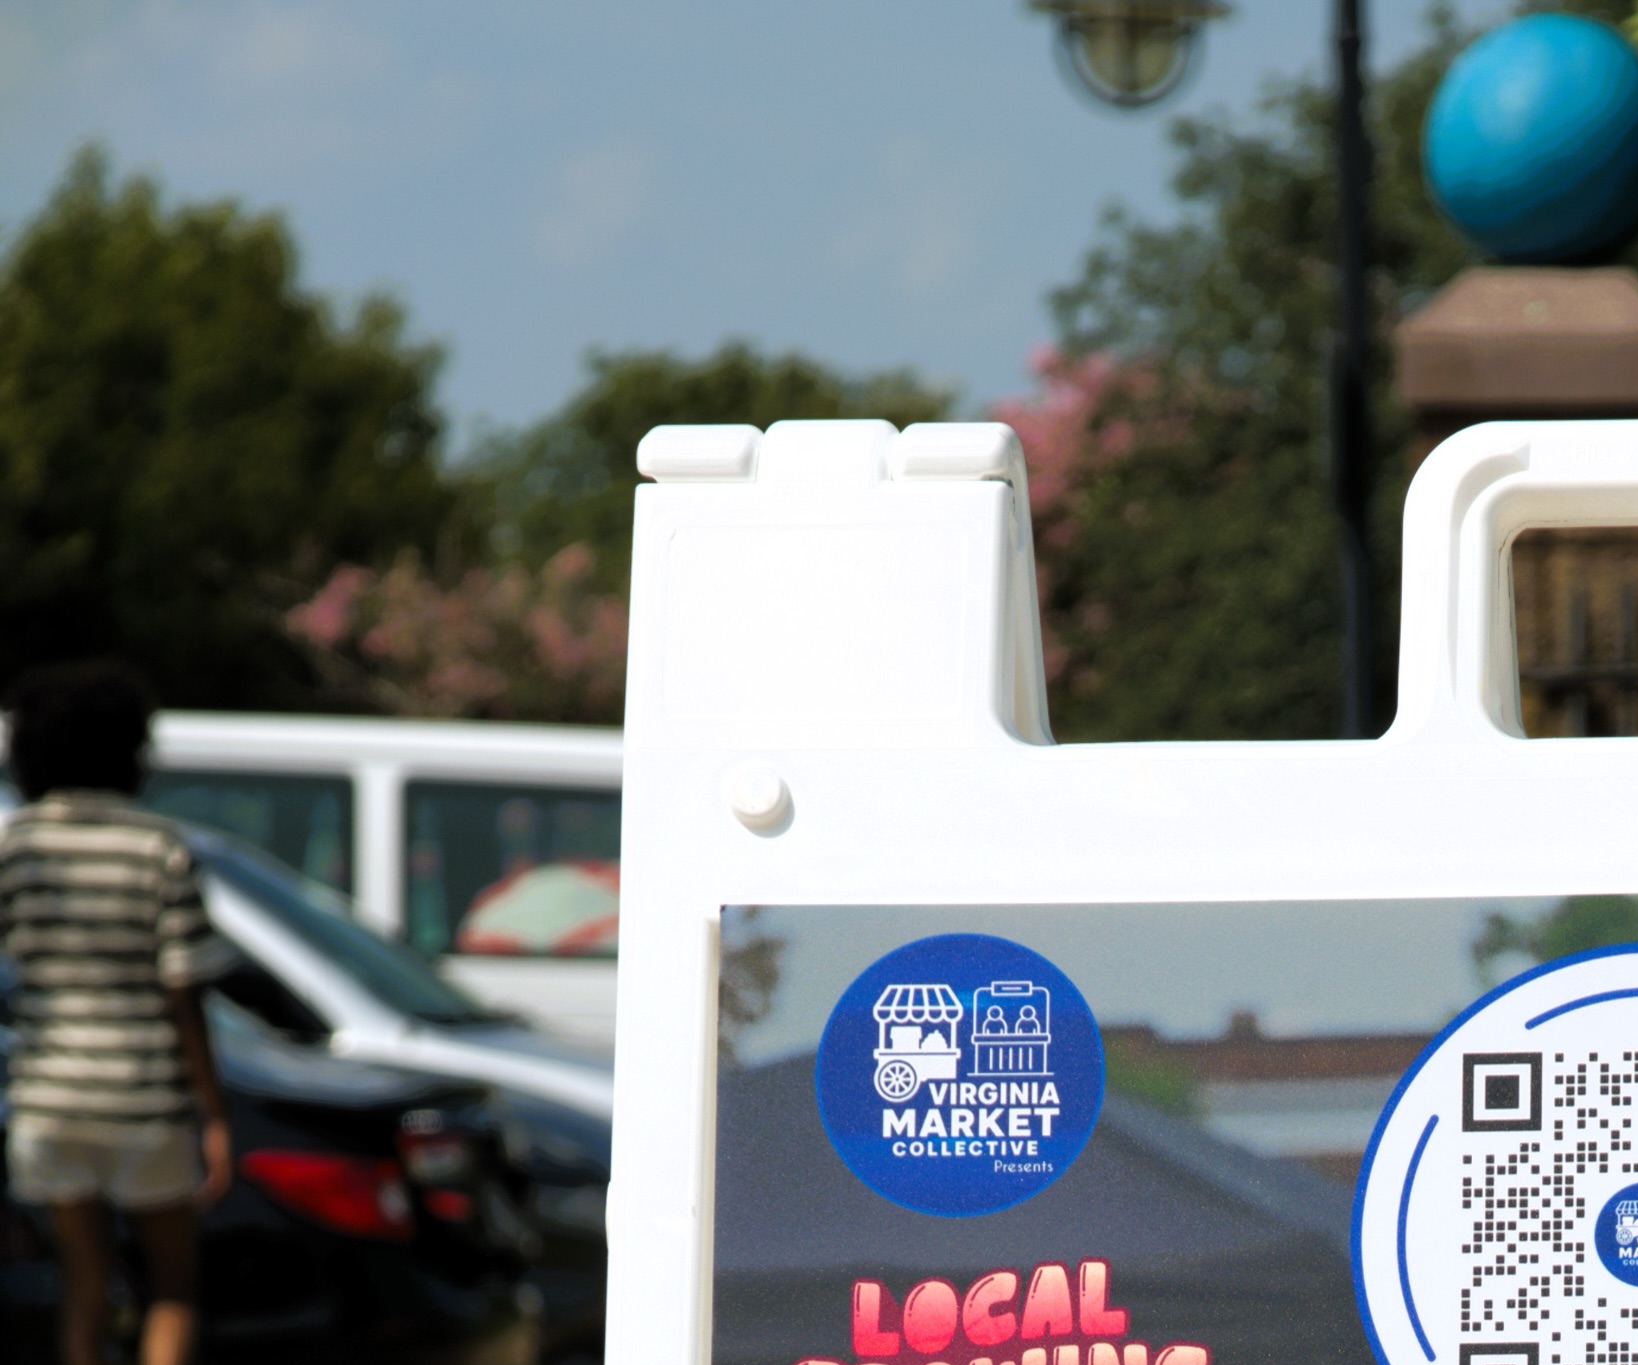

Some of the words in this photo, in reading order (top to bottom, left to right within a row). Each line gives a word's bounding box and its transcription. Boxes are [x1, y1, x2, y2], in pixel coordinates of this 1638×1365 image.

[929, 1082, 1061, 1105] VIRGINIA
[882, 1107, 1060, 1138] MARKET
[892, 1139, 1038, 1157] COLLECTIVE
[993, 1159, 1054, 1173] Presents
[850, 1258, 1130, 1358] LOCAL
